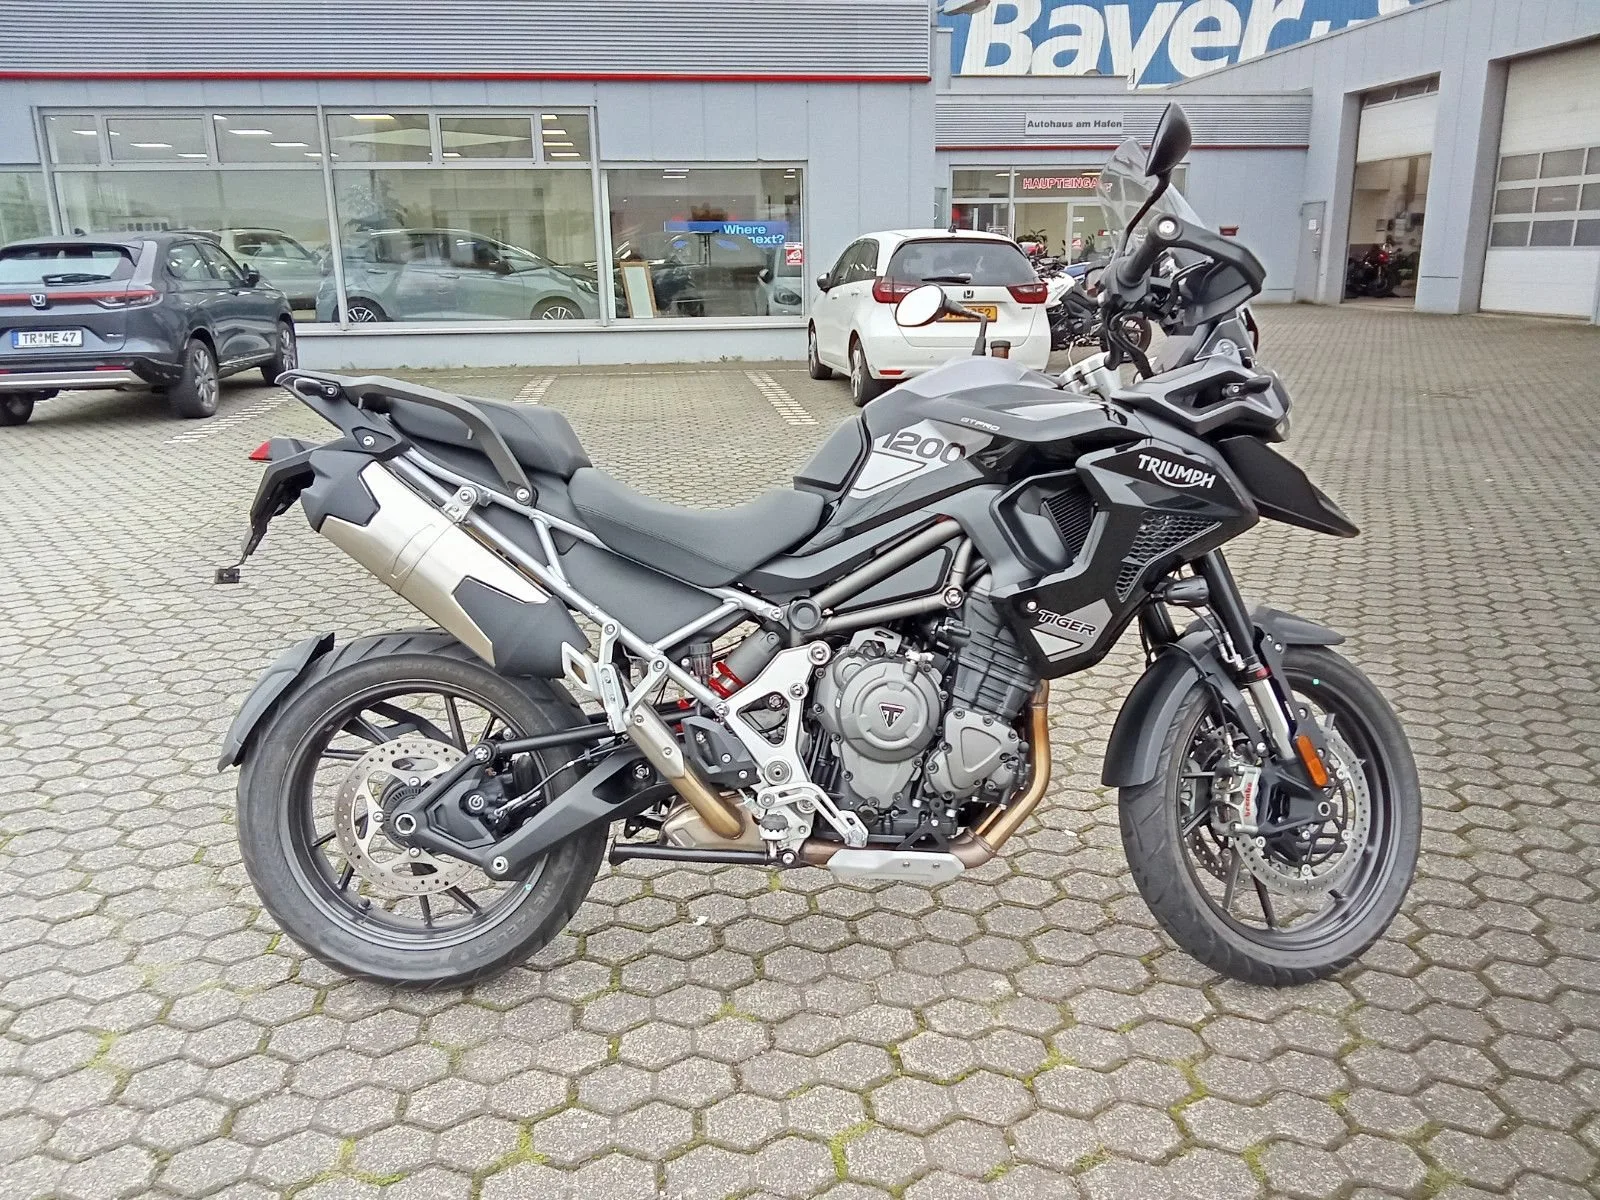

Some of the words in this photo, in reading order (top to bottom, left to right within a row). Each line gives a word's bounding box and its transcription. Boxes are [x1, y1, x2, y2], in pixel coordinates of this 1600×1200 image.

[1027, 120, 1073, 128] Autohaus
[1093, 120, 1122, 128] Hafen
[723, 224, 767, 235] Where
[748, 234, 785, 244] next?
[22, 334, 38, 343] TR
[45, 333, 60, 343] ME
[62, 332, 76, 342] 47
[881, 431, 966, 464] 1200
[1138, 453, 1217, 489] TRIUMPH
[1038, 609, 1098, 637] TIGER
[1244, 782, 1253, 816] brembo
